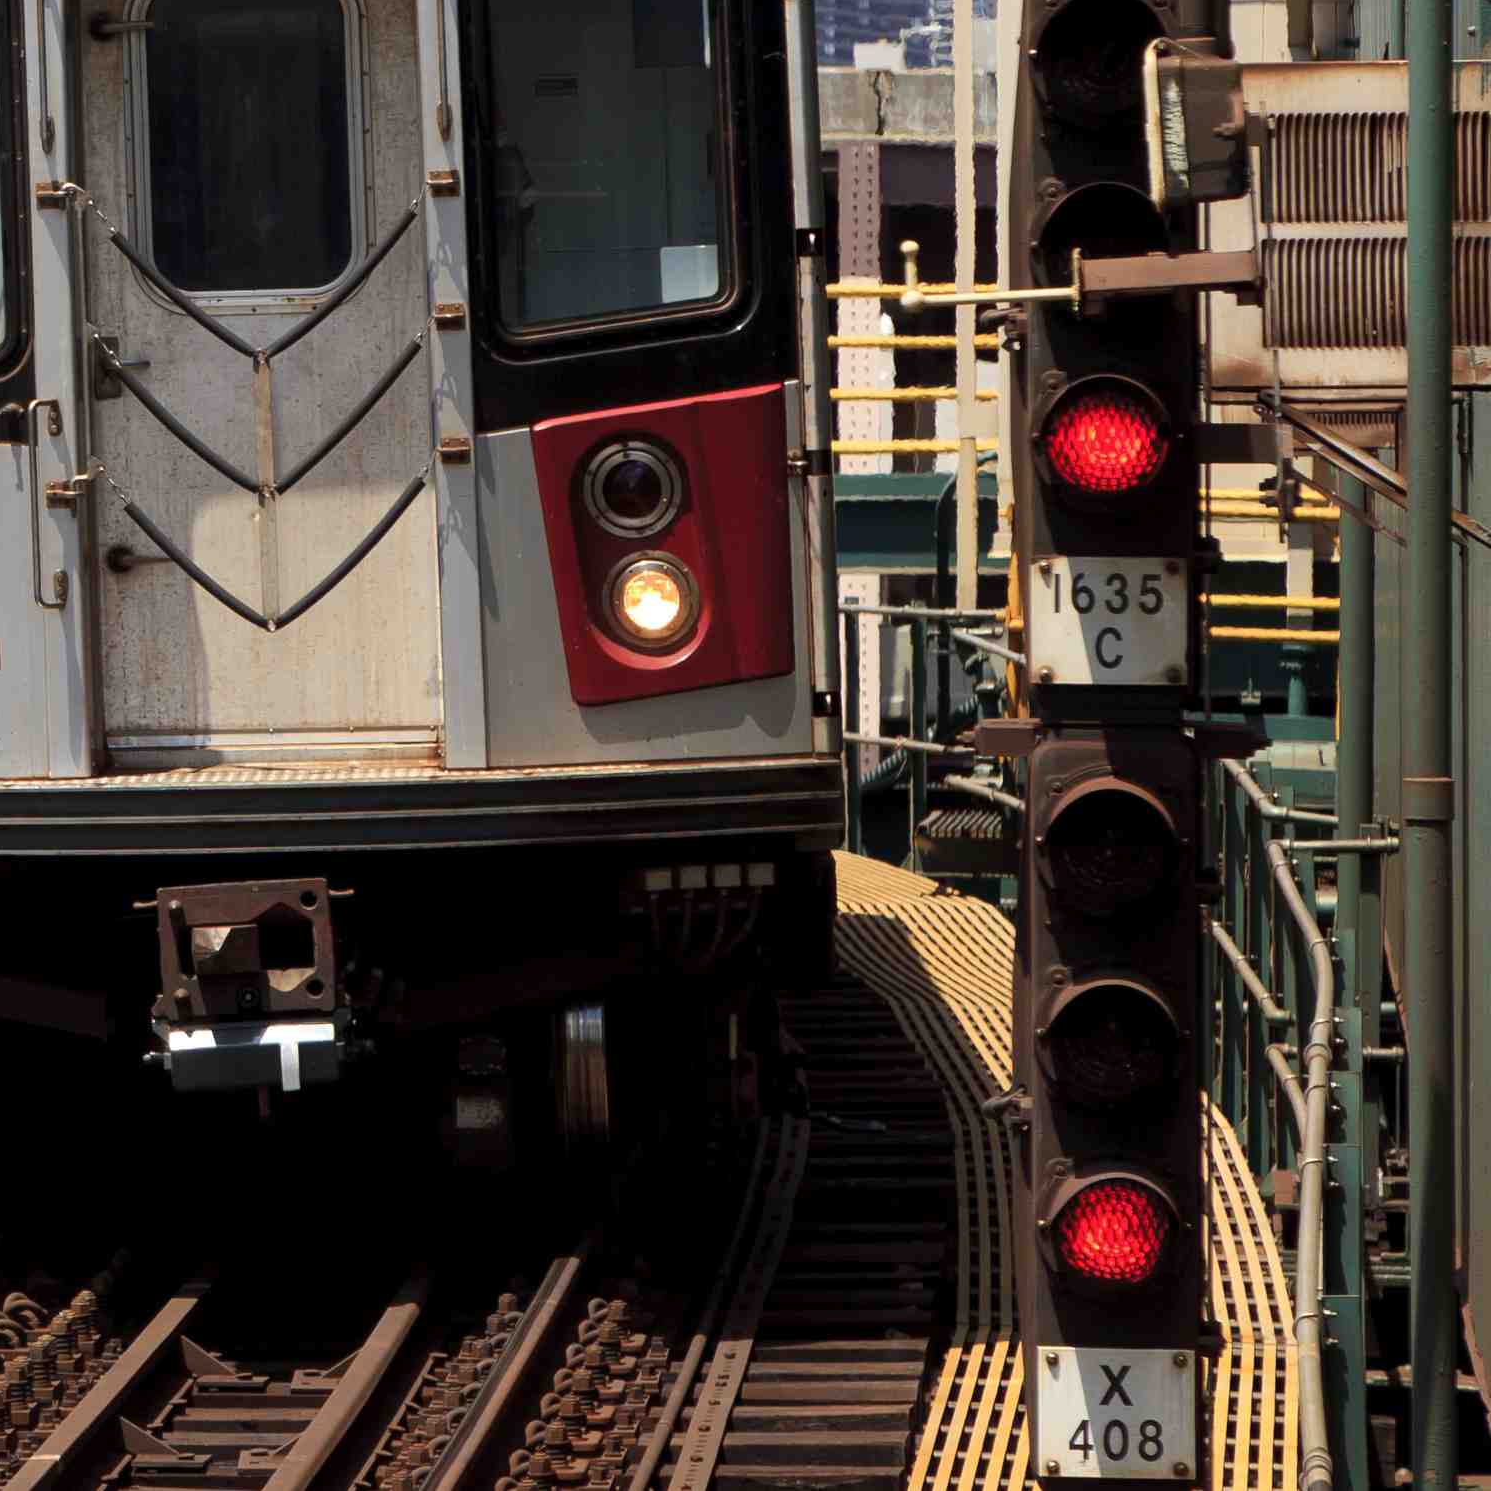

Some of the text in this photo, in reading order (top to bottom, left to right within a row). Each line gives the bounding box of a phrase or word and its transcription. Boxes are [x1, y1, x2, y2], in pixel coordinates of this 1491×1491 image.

[1052, 572, 1164, 616] 1635
[1095, 627, 1124, 669] C
[1100, 1365, 1134, 1407] X
[1068, 1420, 1165, 1462] 408
